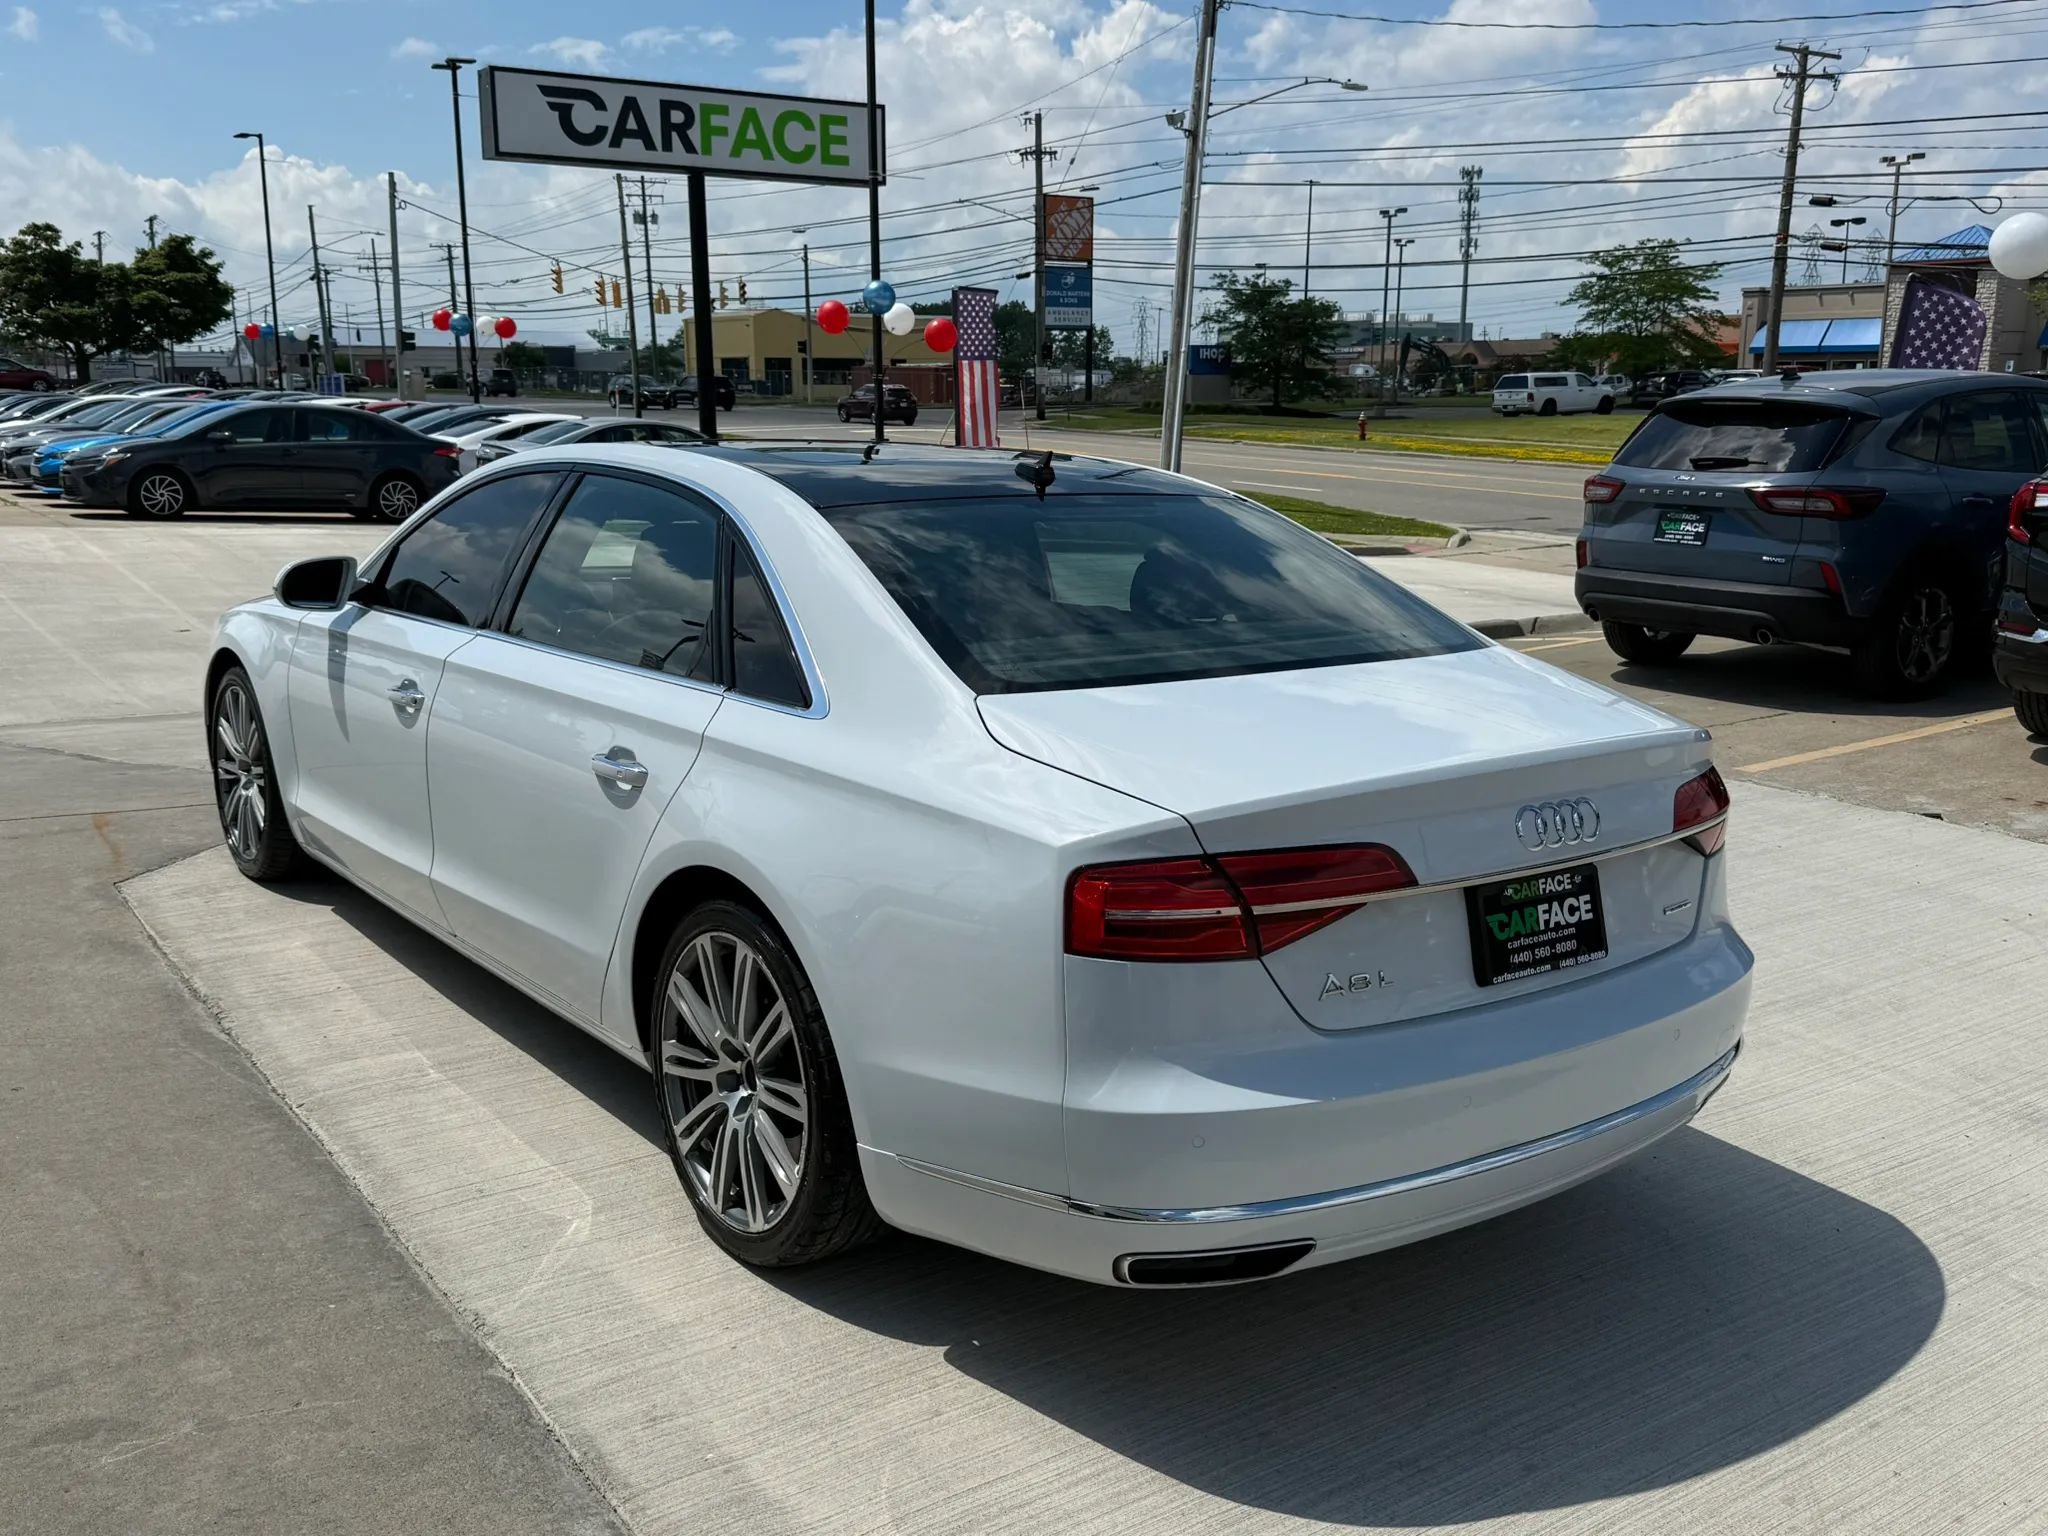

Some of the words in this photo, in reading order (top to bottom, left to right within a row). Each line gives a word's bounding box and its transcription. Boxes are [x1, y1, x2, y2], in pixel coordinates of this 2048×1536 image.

[536, 84, 850, 167] CARFACE
[1639, 488, 1723, 498] ESCAPE
[1661, 520, 1705, 532] CARFACE
[1506, 873, 1572, 900] CARFACE
[1485, 894, 1593, 940] CARFACE
[1507, 927, 1576, 949] carfaceauto.com
[1510, 949, 1533, 964] (440)
[1493, 963, 1551, 984] carfaceauto.com
